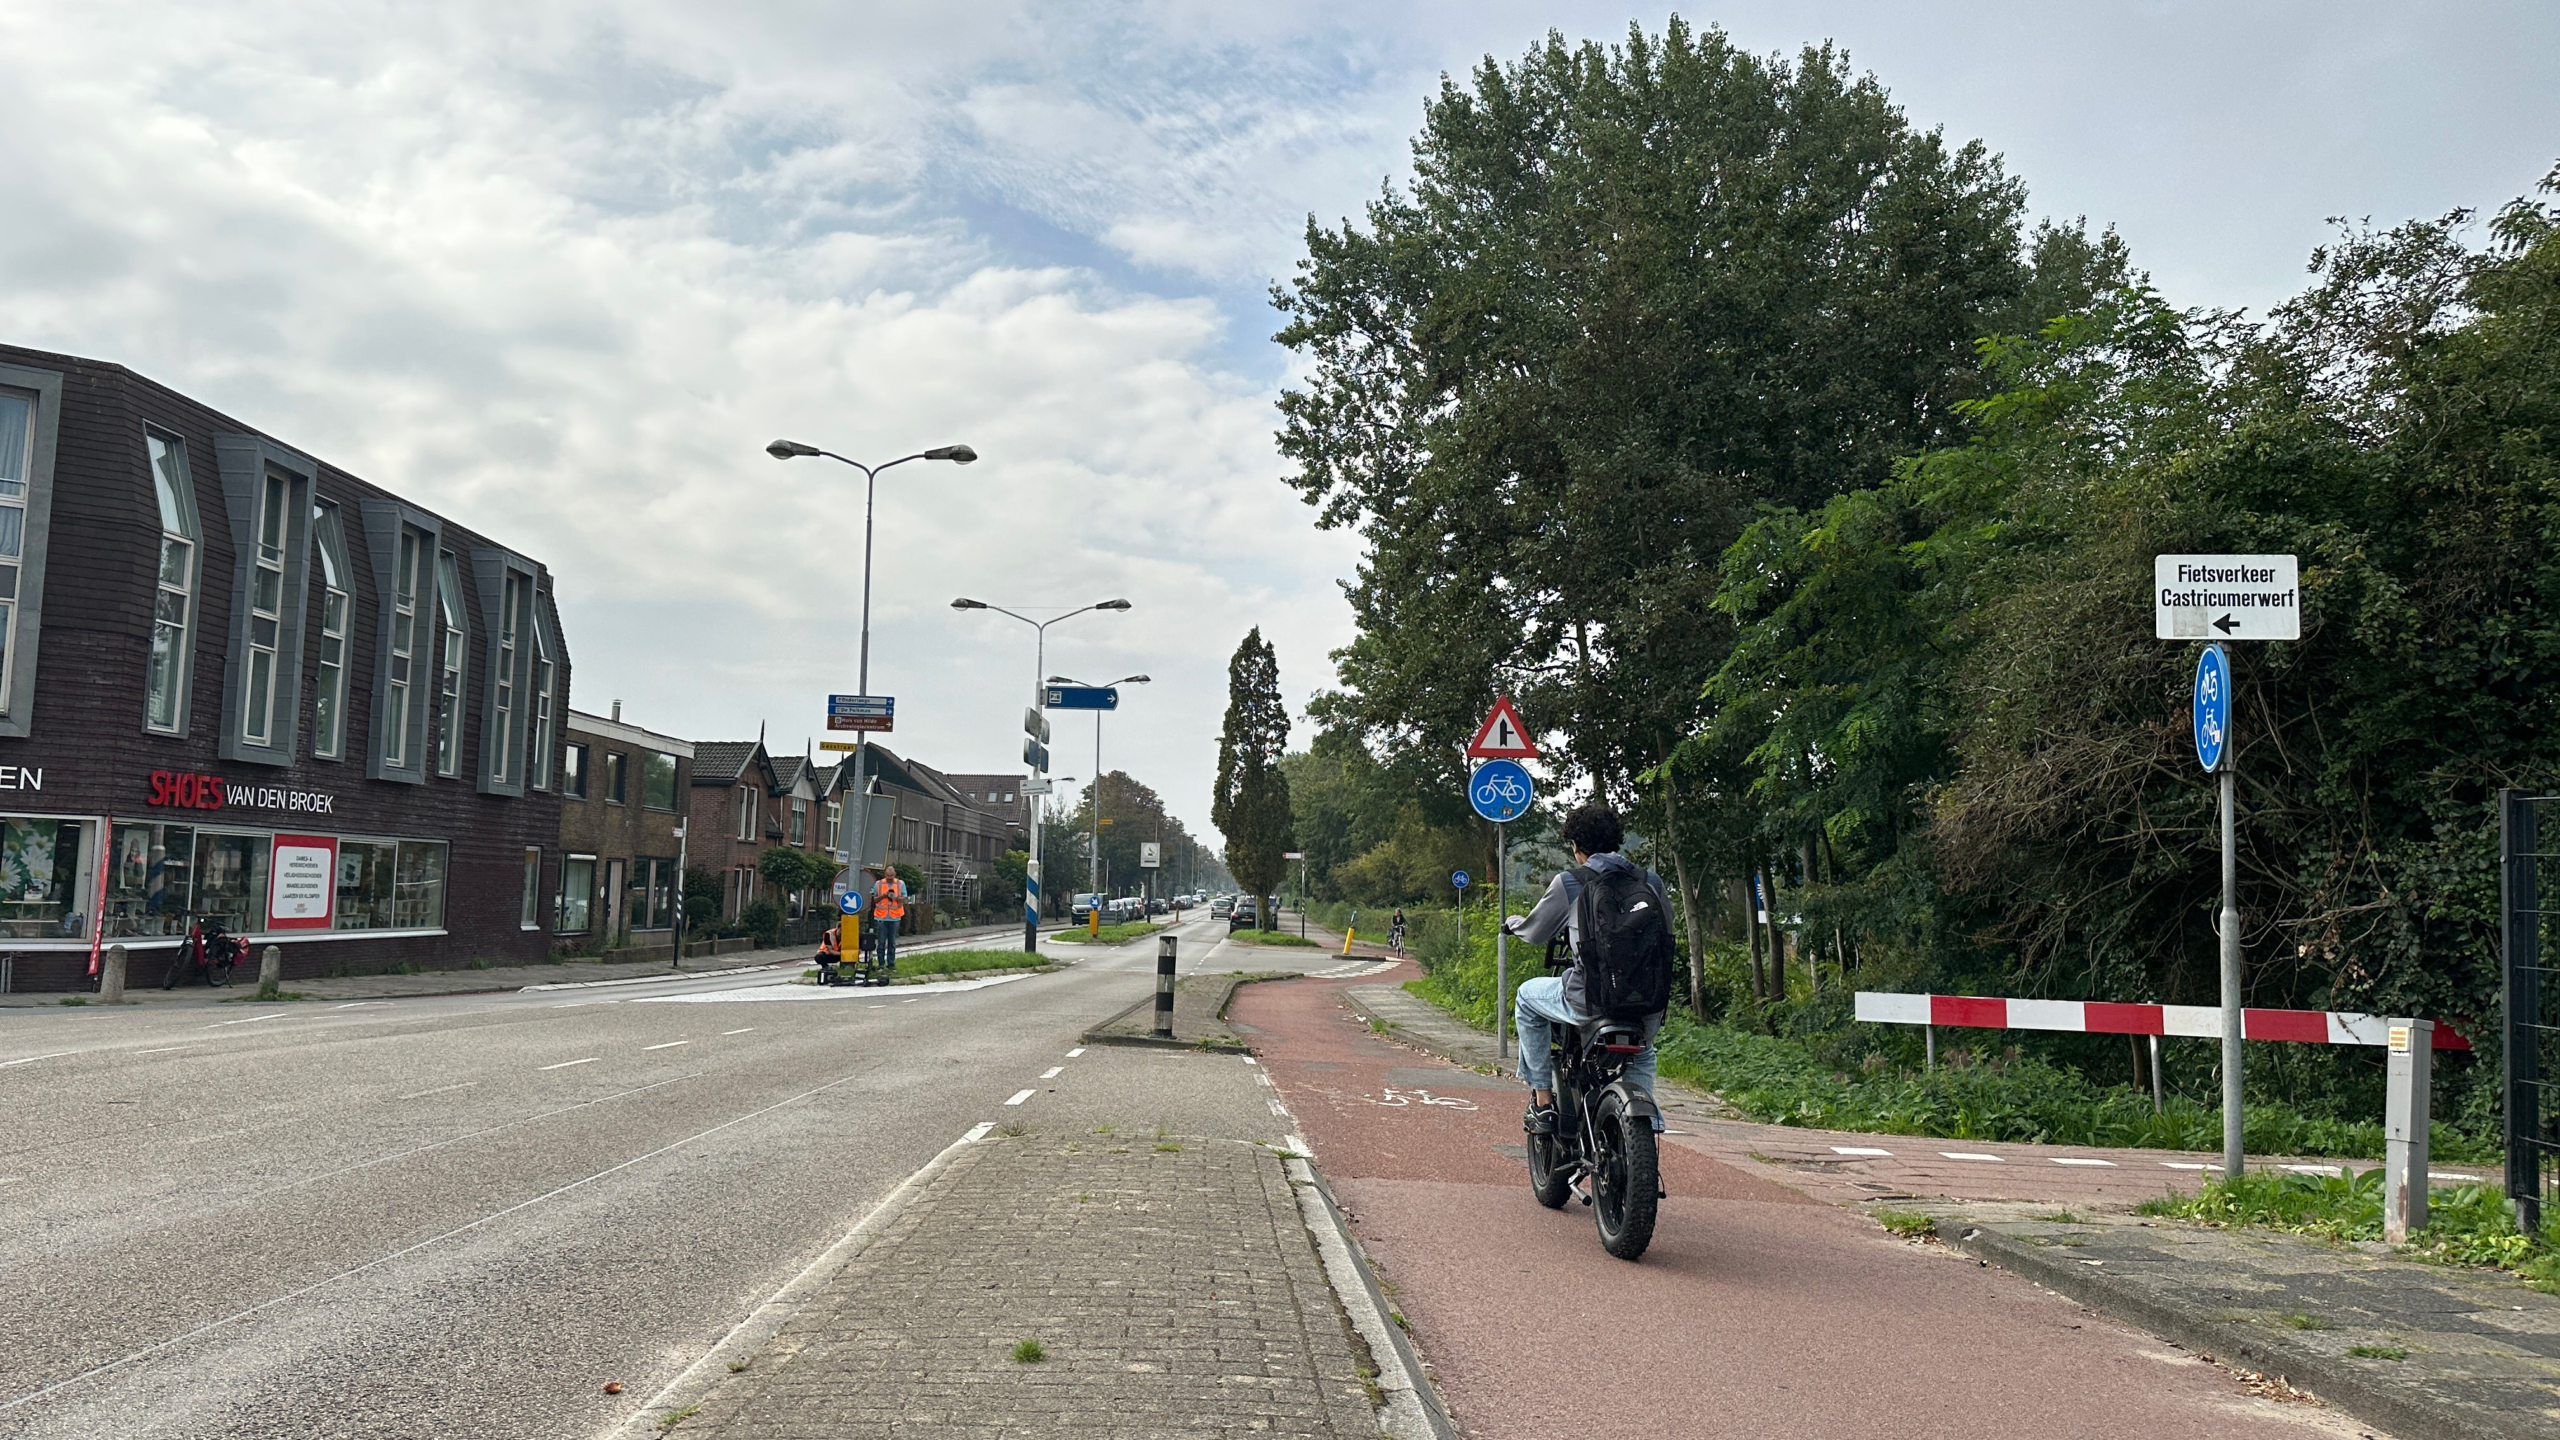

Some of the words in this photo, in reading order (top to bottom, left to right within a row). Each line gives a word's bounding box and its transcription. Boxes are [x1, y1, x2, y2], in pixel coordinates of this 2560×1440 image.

[2178, 564, 2275, 583] Fietsverkeer
[2161, 588, 2294, 607] Castricumerwerf
[0, 765, 43, 791] EN
[148, 770, 223, 808] SHOES
[226, 784, 255, 806] VAN
[258, 788, 286, 810] DEN
[289, 791, 334, 814] BROEK
